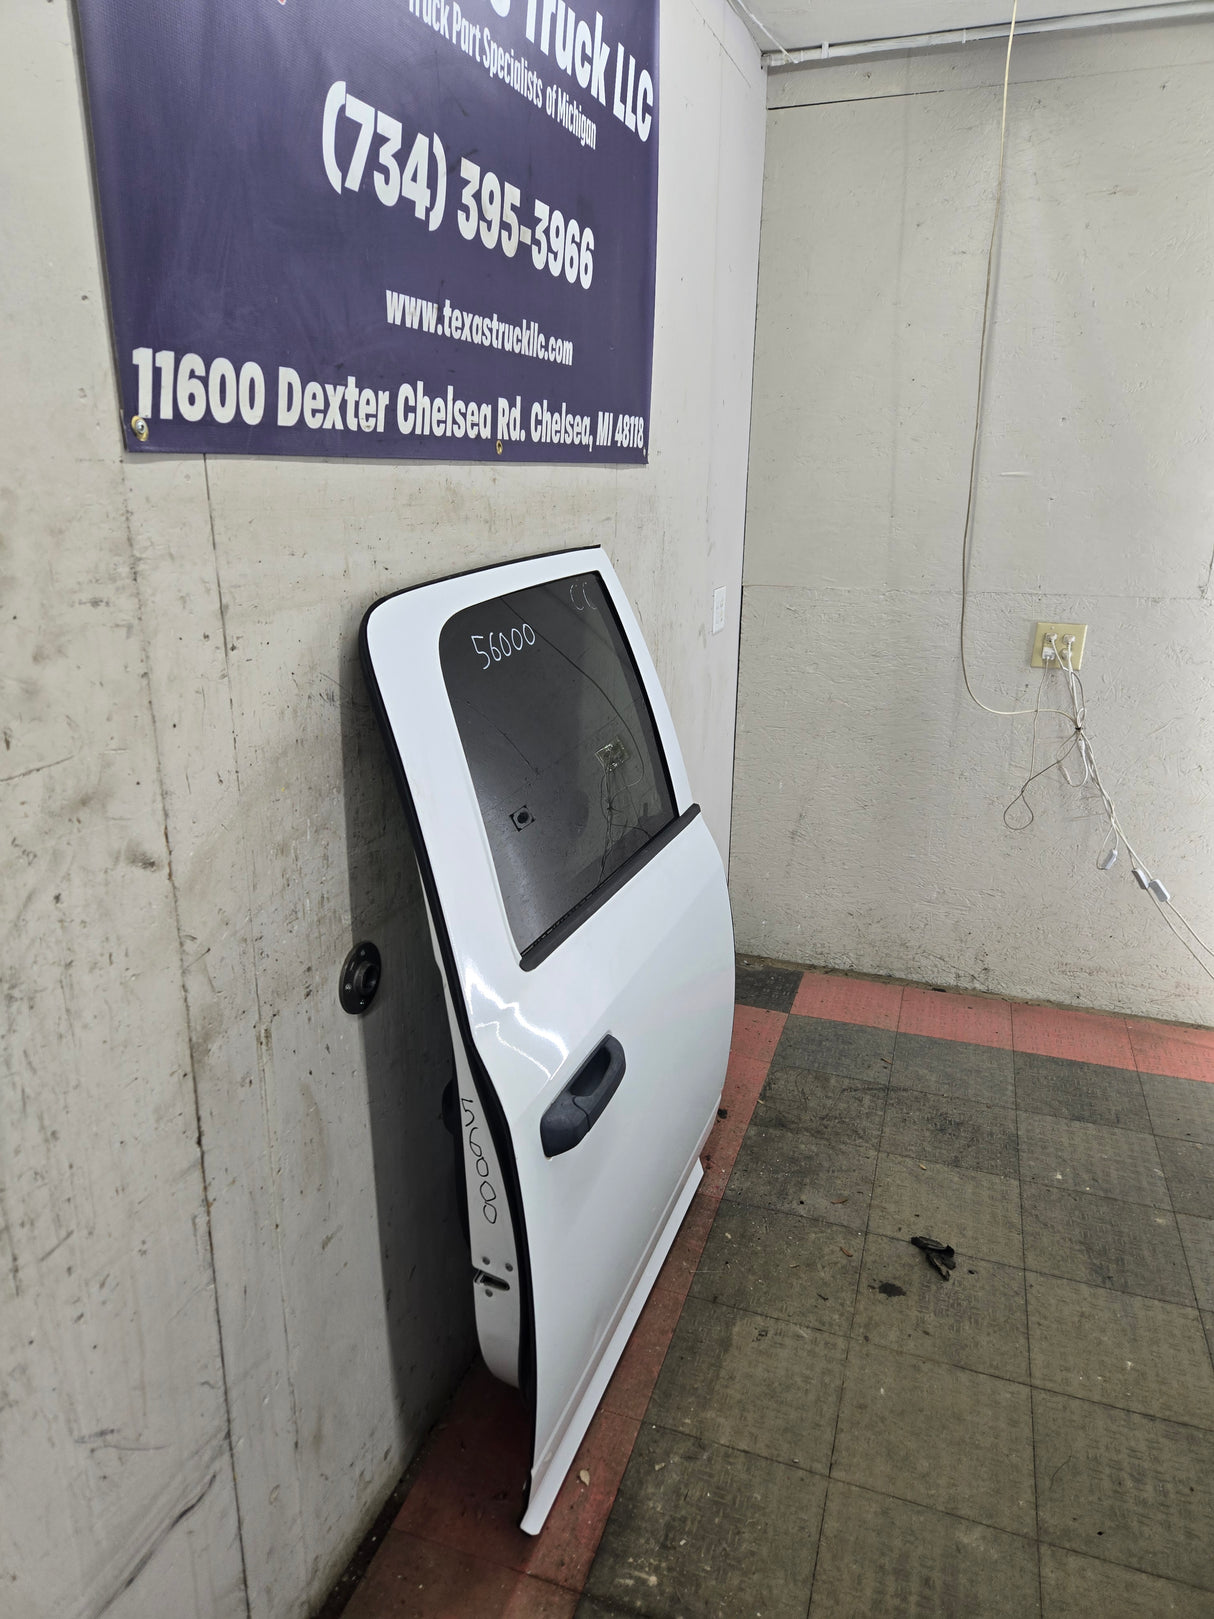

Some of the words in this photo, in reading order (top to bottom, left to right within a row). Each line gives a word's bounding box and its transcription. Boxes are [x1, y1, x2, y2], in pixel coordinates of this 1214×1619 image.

[409, 0, 449, 40] uck
[452, 1, 481, 62] Part
[482, 27, 543, 109] Specialists
[545, 84, 557, 119] of
[557, 87, 597, 150] Michigan
[612, 42, 653, 142] LLC
[322, 80, 447, 232] (734)
[457, 157, 595, 290] 395-3966
[385, 289, 573, 366] www.texastruckllc.com
[132, 347, 265, 426] 11600
[277, 366, 390, 433] Dexter
[396, 381, 492, 440] Chelsea
[497, 395, 526, 442] Rd.
[530, 399, 594, 452] Chelsea,
[596, 411, 613, 447] MI
[614, 414, 645, 448] 48118
[471, 623, 536, 670] 56000
[461, 1098, 498, 1225] 56000
